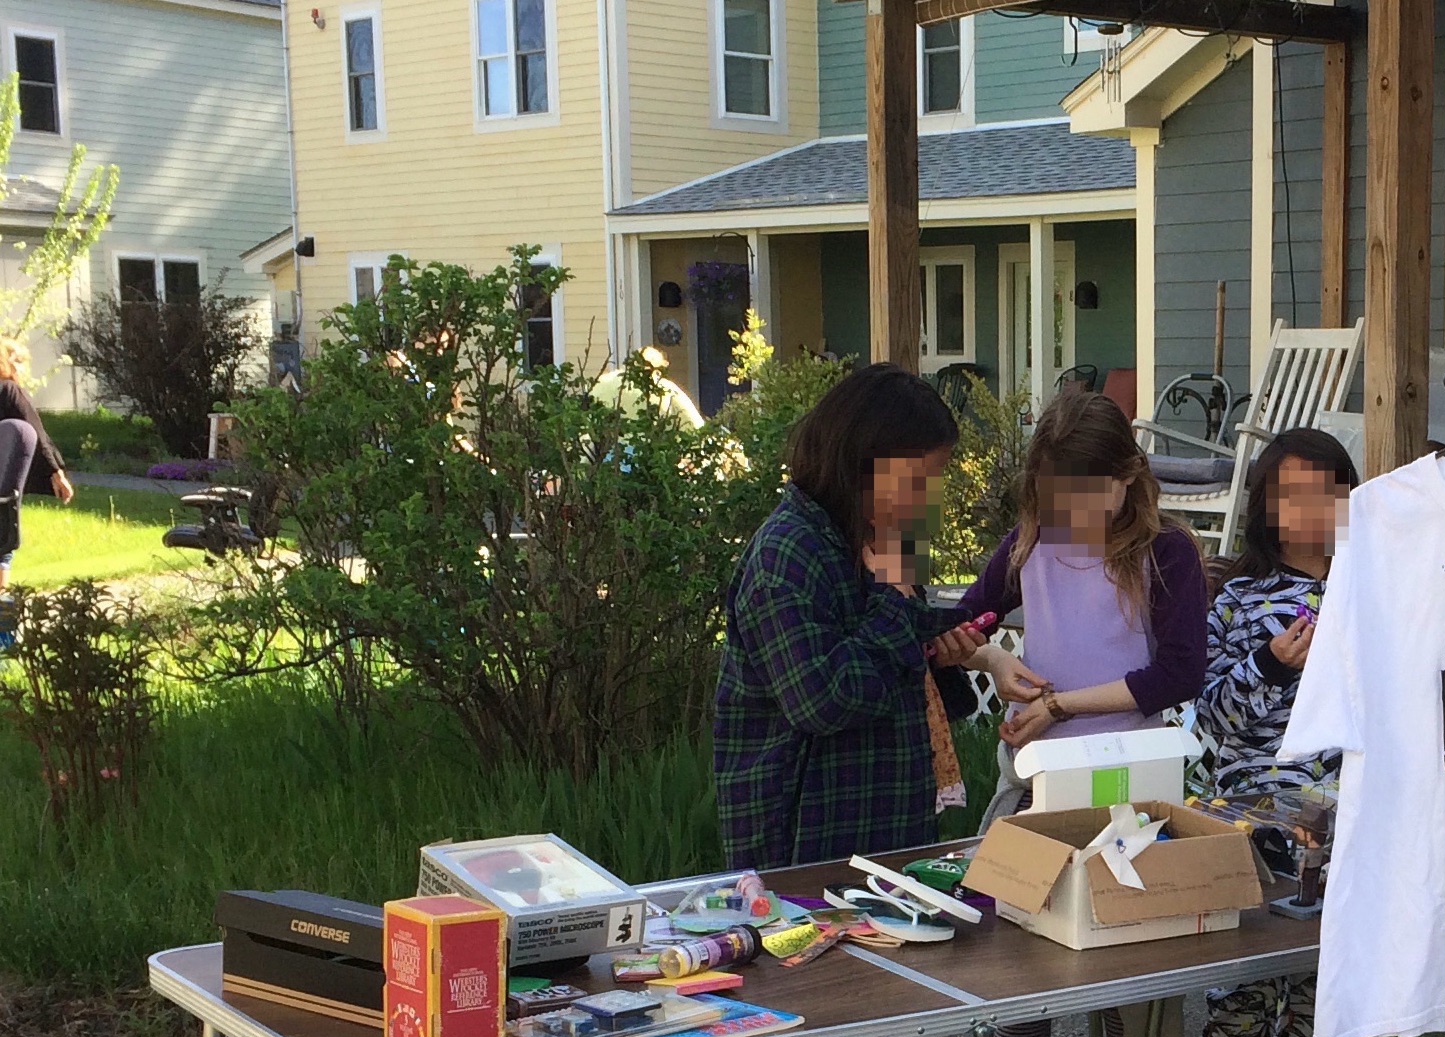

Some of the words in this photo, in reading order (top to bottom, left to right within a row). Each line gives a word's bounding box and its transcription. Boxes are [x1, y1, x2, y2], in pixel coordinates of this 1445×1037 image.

[518, 918, 553, 928] tasco
[290, 919, 351, 944] CONVERSE
[518, 929, 531, 939] 750
[533, 926, 558, 937] POWER
[560, 920, 604, 933] MICROSCOPE
[449, 975, 488, 994] WEBSTER'S
[460, 983, 488, 994] POCKET
[451, 990, 488, 1001] REFERENCE
[456, 997, 482, 1008] LIBRARY
